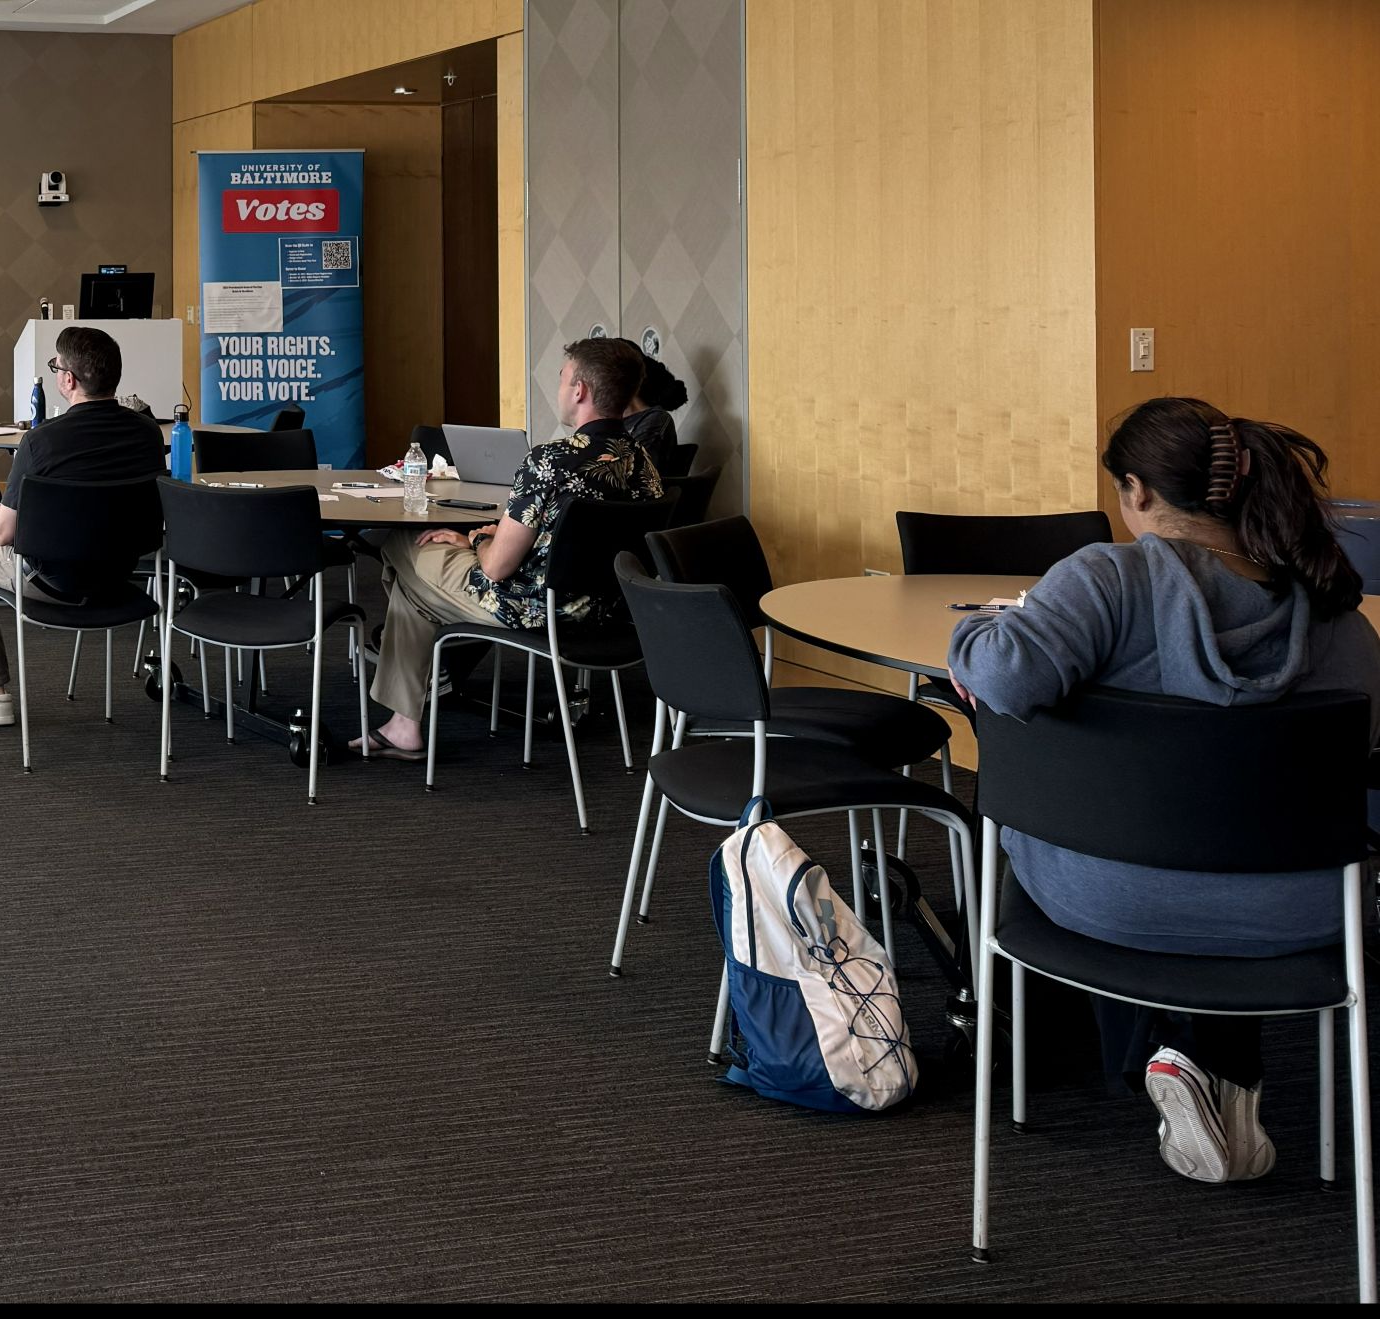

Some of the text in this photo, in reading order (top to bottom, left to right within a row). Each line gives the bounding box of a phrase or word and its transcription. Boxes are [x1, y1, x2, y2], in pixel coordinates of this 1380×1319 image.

[230, 172, 332, 184] BALTIMORE
[241, 164, 303, 172] UNIVERSITY
[236, 199, 326, 221] Votes
[218, 336, 336, 356] YOUR RIGHTS.
[218, 358, 322, 378] YOUR VOICE.
[218, 381, 316, 401] YOUR VOTE.
